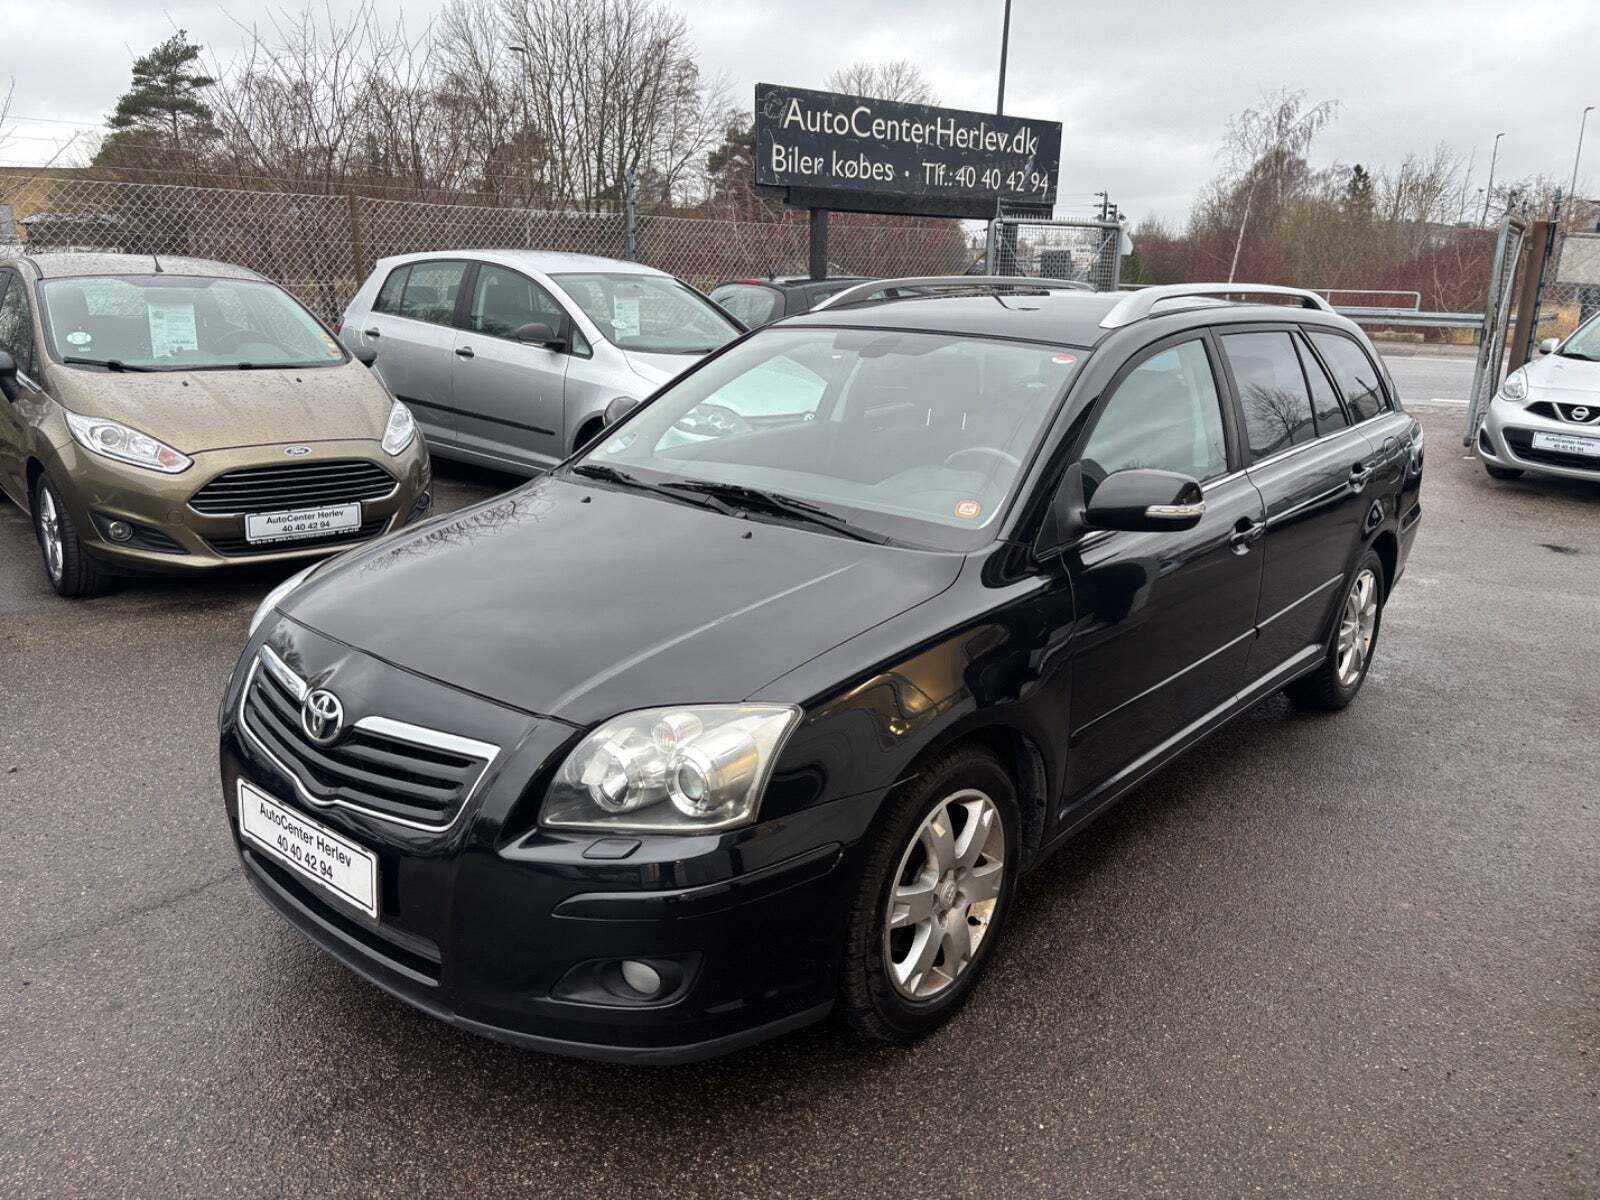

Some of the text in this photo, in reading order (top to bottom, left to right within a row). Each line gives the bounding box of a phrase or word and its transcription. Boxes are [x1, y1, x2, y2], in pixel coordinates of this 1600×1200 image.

[772, 144, 824, 174] Biler
[832, 150, 894, 181] købes
[981, 168, 1001, 189] 40
[1006, 171, 1025, 192] 42
[1031, 172, 1049, 196] 94
[267, 510, 344, 524] AutoCenter Herlev
[282, 524, 293, 532] 40
[295, 523, 306, 531] 40
[260, 803, 351, 867] AutoCenter Herlev
[276, 834, 333, 880] 40 40 42 94
